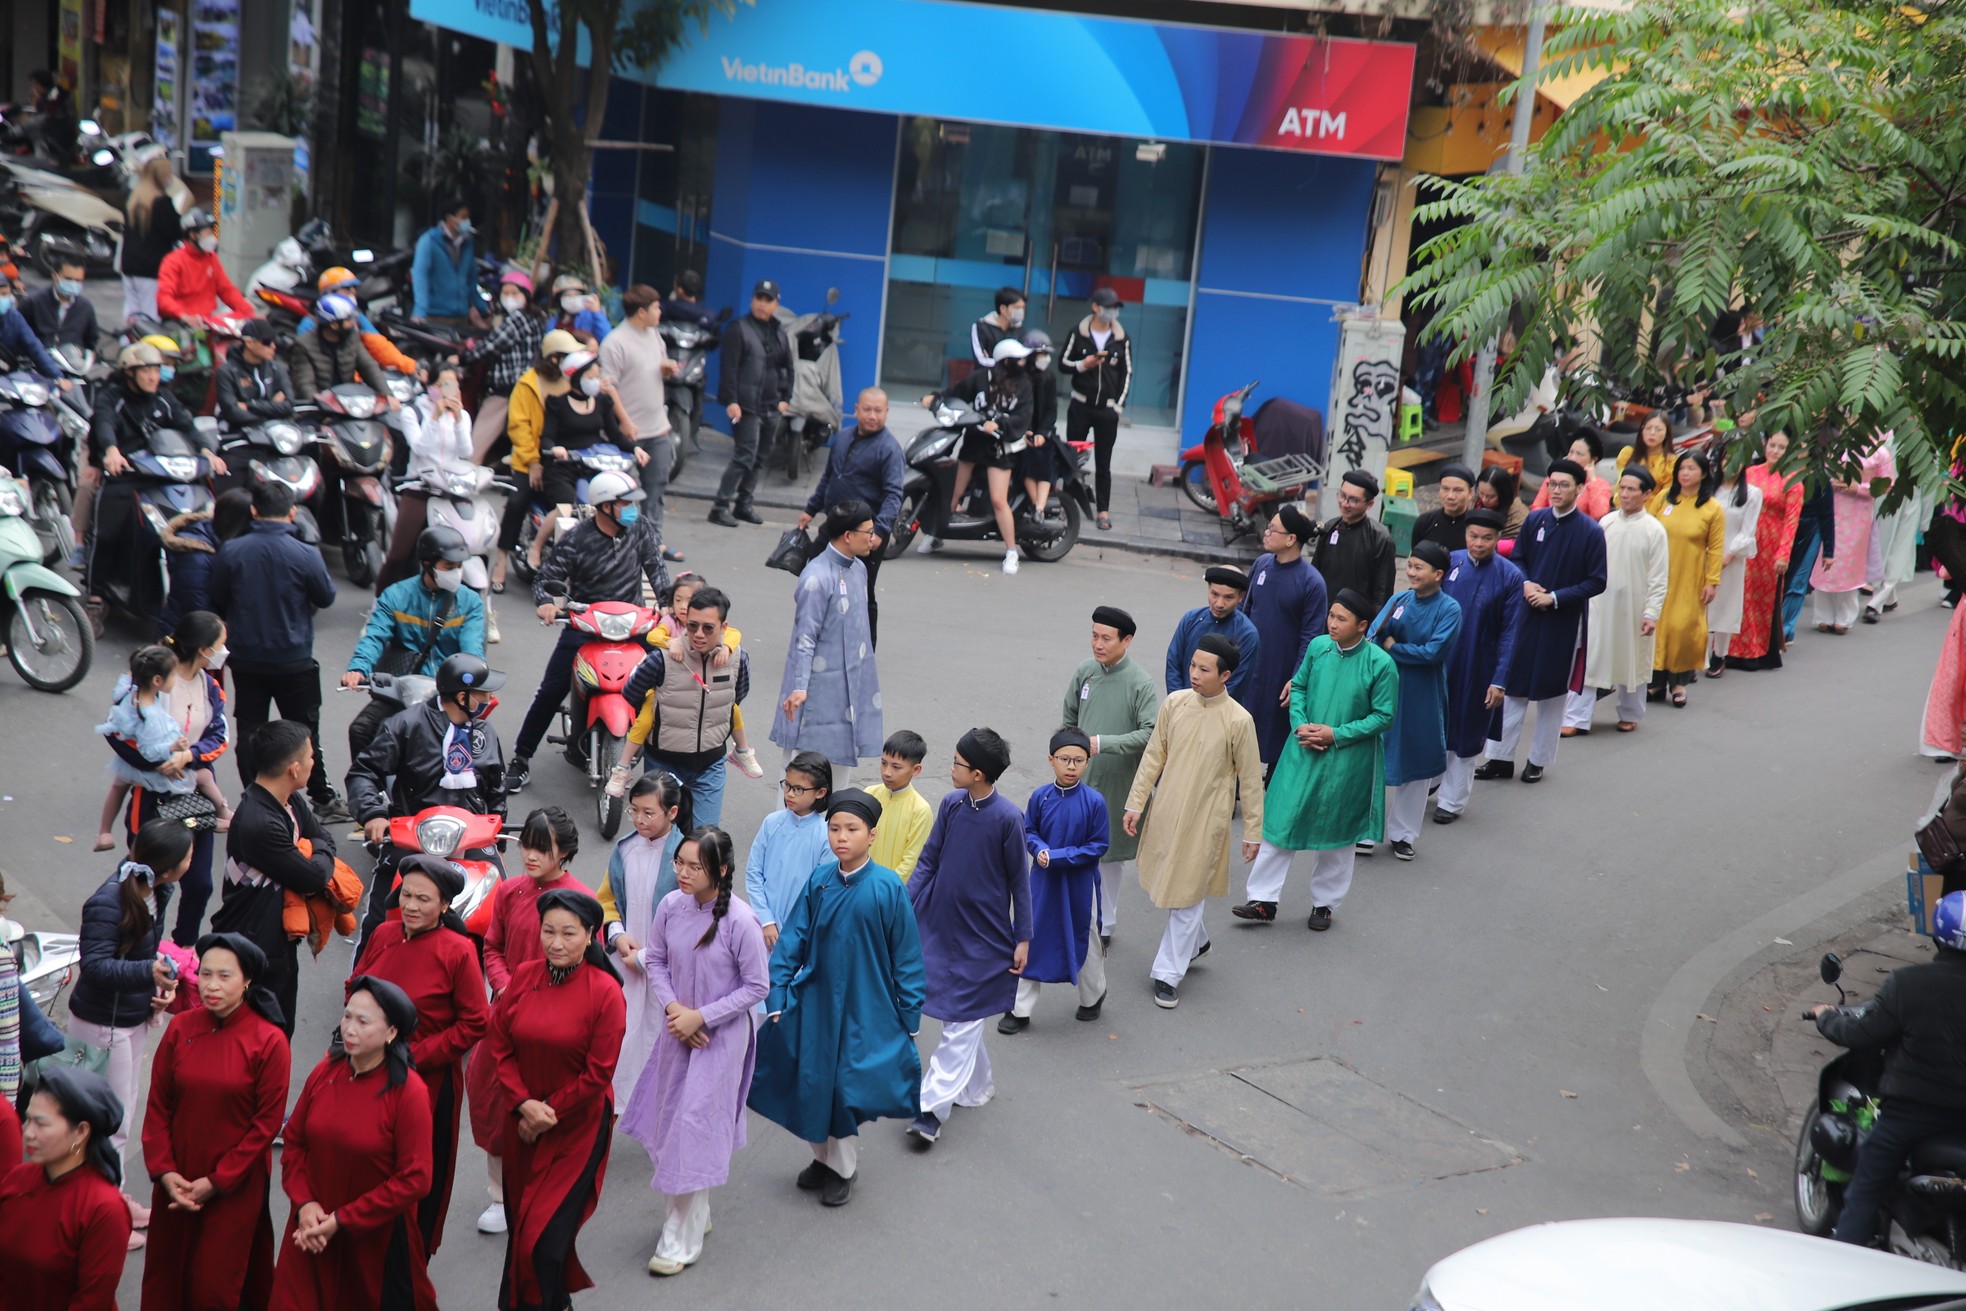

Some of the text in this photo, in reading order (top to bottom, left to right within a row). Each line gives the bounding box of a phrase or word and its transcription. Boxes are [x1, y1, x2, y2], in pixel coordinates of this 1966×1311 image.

[473, 0, 561, 34] ietinBk
[721, 55, 850, 92] VietinBank
[1278, 106, 1347, 140] ATM
